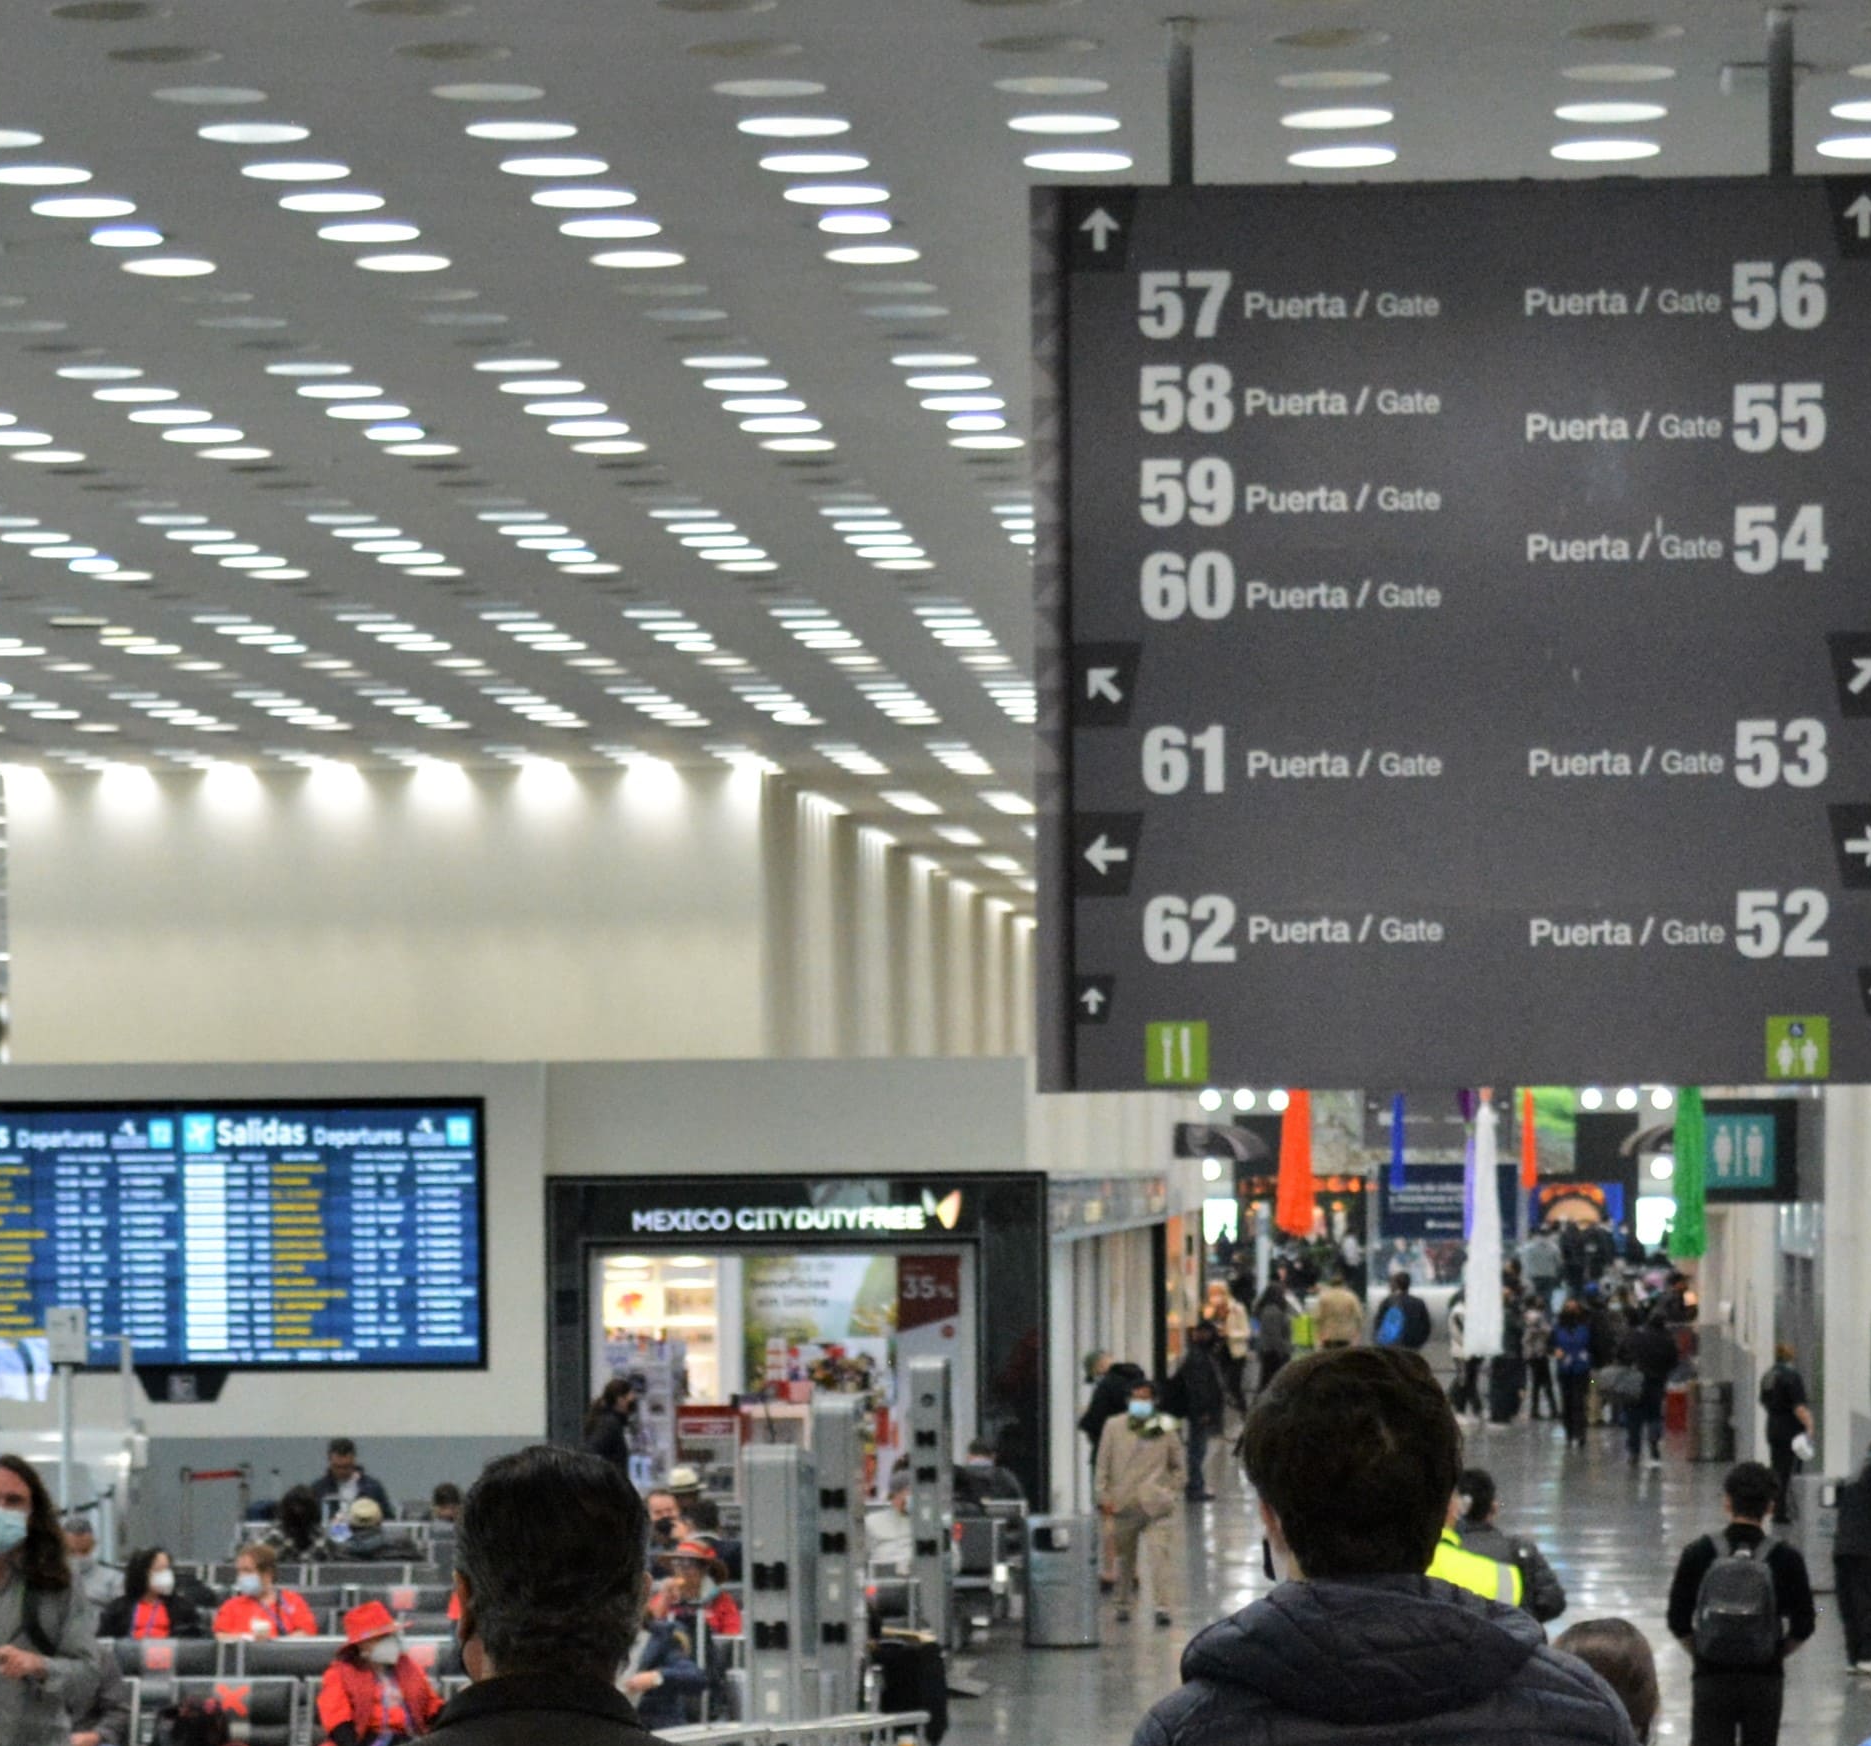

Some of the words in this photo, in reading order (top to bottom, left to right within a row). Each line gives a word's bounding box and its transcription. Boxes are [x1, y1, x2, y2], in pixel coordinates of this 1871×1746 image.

[1139, 271, 1231, 339] 57
[1245, 292, 1347, 319] Puerta
[1376, 293, 1440, 318] Gate
[1525, 288, 1628, 316] Puerta
[1657, 288, 1721, 314] Gate
[1732, 260, 1826, 330] 56
[1140, 364, 1234, 433] 58
[1245, 388, 1348, 416] Puerta
[1377, 389, 1441, 415] Gate
[1526, 413, 1629, 441] Puerta
[1658, 413, 1722, 439] Gate
[1733, 383, 1826, 452] 55
[1140, 457, 1234, 526] 59
[1246, 485, 1349, 513] Puerta
[1377, 486, 1441, 511] Gate
[1527, 533, 1630, 562] Puerta
[1657, 534, 1722, 560] Gate
[1734, 505, 1828, 574] 54
[1141, 550, 1235, 620] 60
[1246, 581, 1349, 609] Puerta
[1378, 582, 1441, 608] Gate
[1142, 725, 1225, 794] 61
[1247, 750, 1350, 778] Puerta
[1379, 752, 1442, 777] Gate
[1529, 748, 1632, 776] Puerta
[1660, 748, 1724, 774] Gate
[1735, 718, 1827, 788] 53
[1144, 894, 1236, 963] 62
[1249, 916, 1351, 943] Puerta
[1380, 917, 1443, 942] Gate
[1530, 918, 1632, 946] Puerta
[1661, 918, 1725, 944] Gate
[1736, 889, 1828, 958] 52
[16, 1129, 106, 1151] Departures
[217, 1119, 306, 1146] Salidas
[313, 1127, 403, 1149] Departures
[632, 1208, 730, 1232] MEXICO
